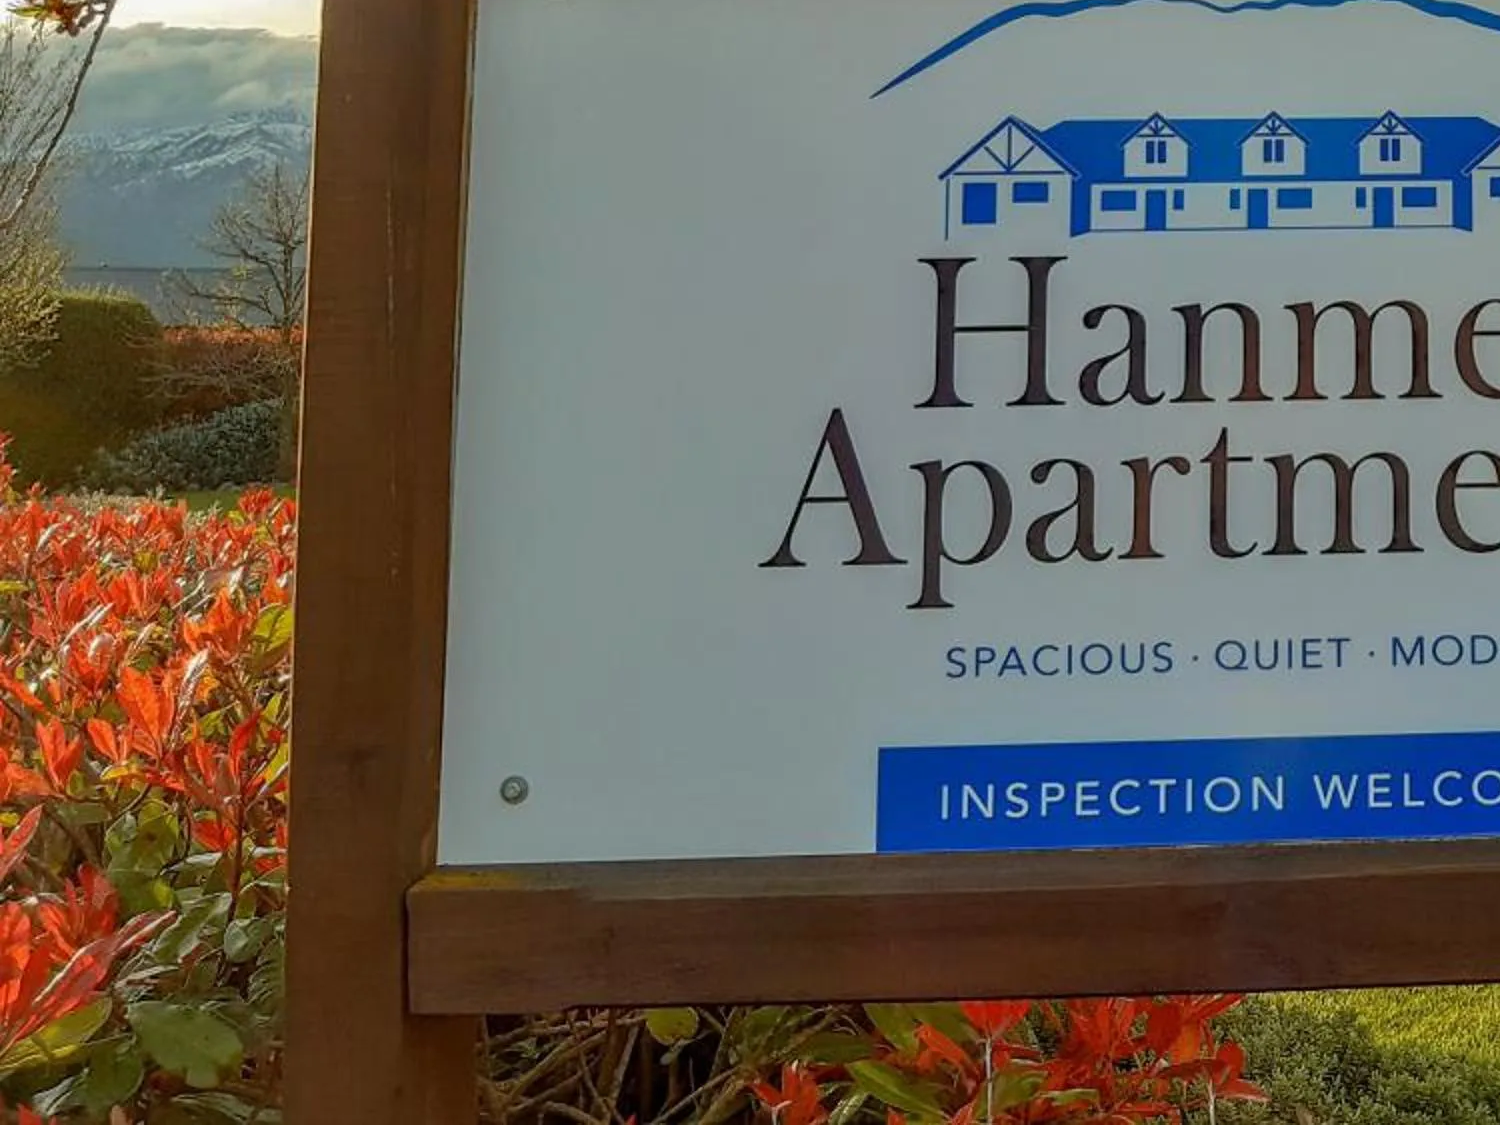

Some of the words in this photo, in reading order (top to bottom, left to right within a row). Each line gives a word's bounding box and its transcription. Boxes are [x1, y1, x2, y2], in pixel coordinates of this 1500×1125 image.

[944, 641, 1174, 679] SPACIOUS
[1213, 636, 1352, 672] QUIET
[939, 775, 1284, 820] INSPECTION
